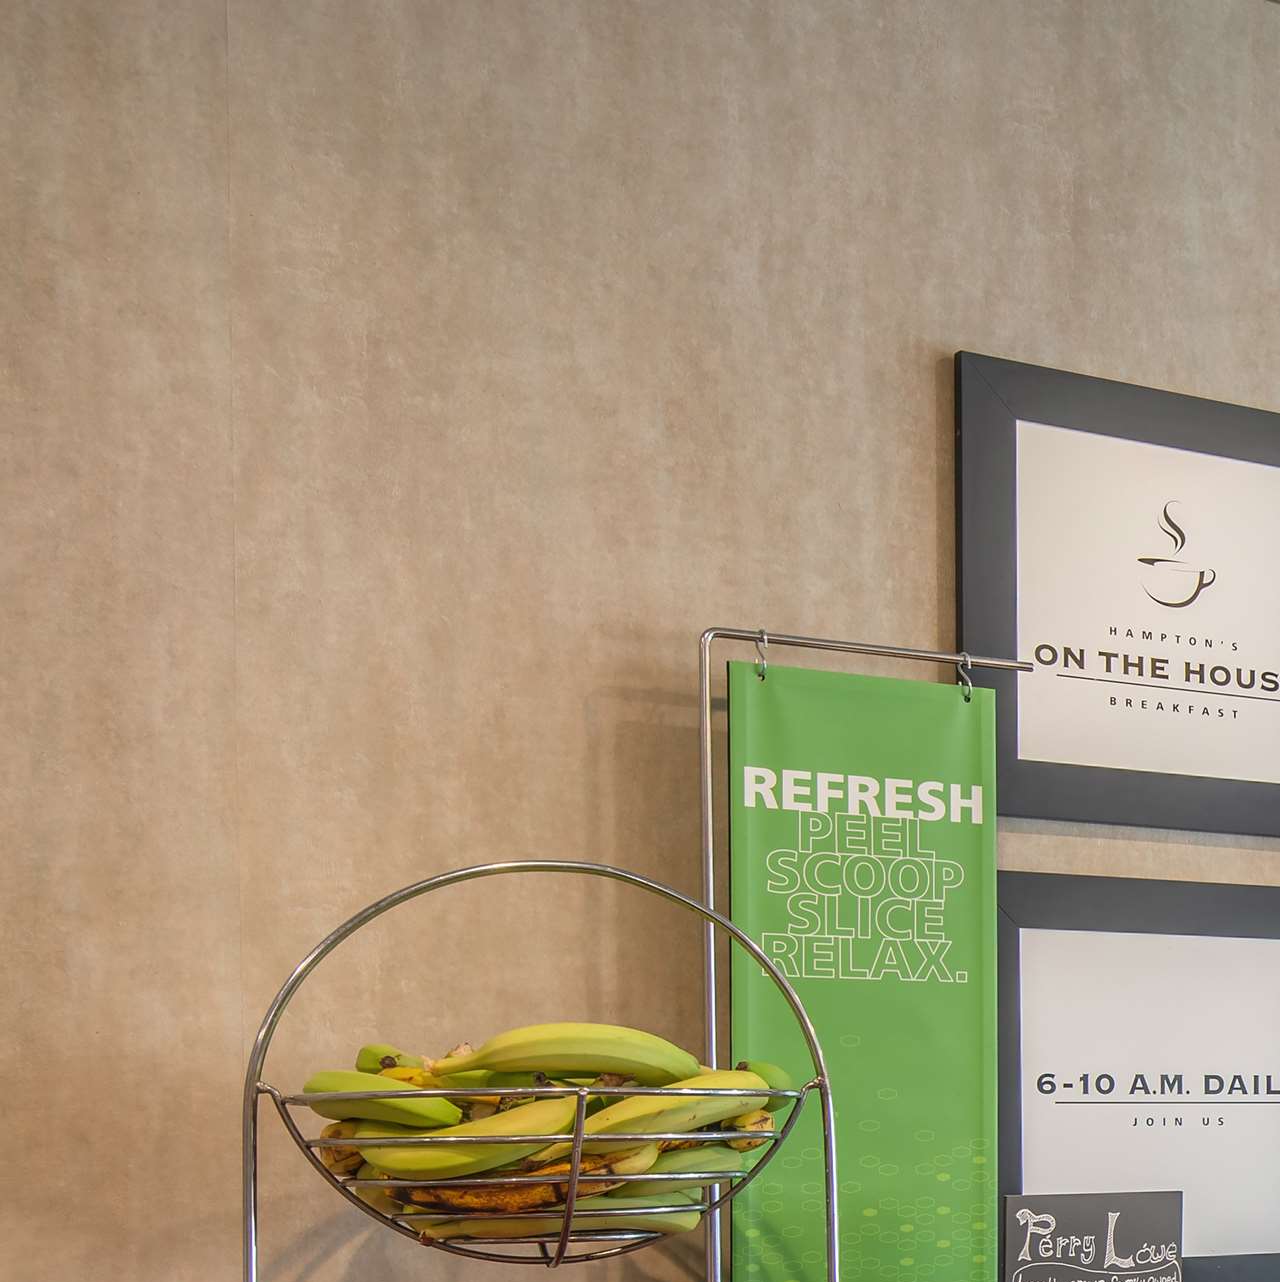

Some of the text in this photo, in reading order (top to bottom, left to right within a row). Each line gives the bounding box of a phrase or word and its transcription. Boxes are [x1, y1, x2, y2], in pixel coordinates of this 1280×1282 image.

[1109, 626, 1238, 651] HAMPTON'S
[1033, 643, 1086, 670] ON
[1097, 650, 1170, 680] THE
[1109, 696, 1238, 719] BREAKFAST
[743, 766, 983, 825] REFRESH
[798, 809, 936, 861] PEEL
[766, 848, 965, 902] SCOOP
[786, 892, 945, 942] SLICE
[761, 932, 968, 984] RELAX.
[1036, 1073, 1117, 1096] 6-10
[1129, 1074, 1191, 1096] A.M.
[1131, 1116, 1225, 1127] JOIN US
